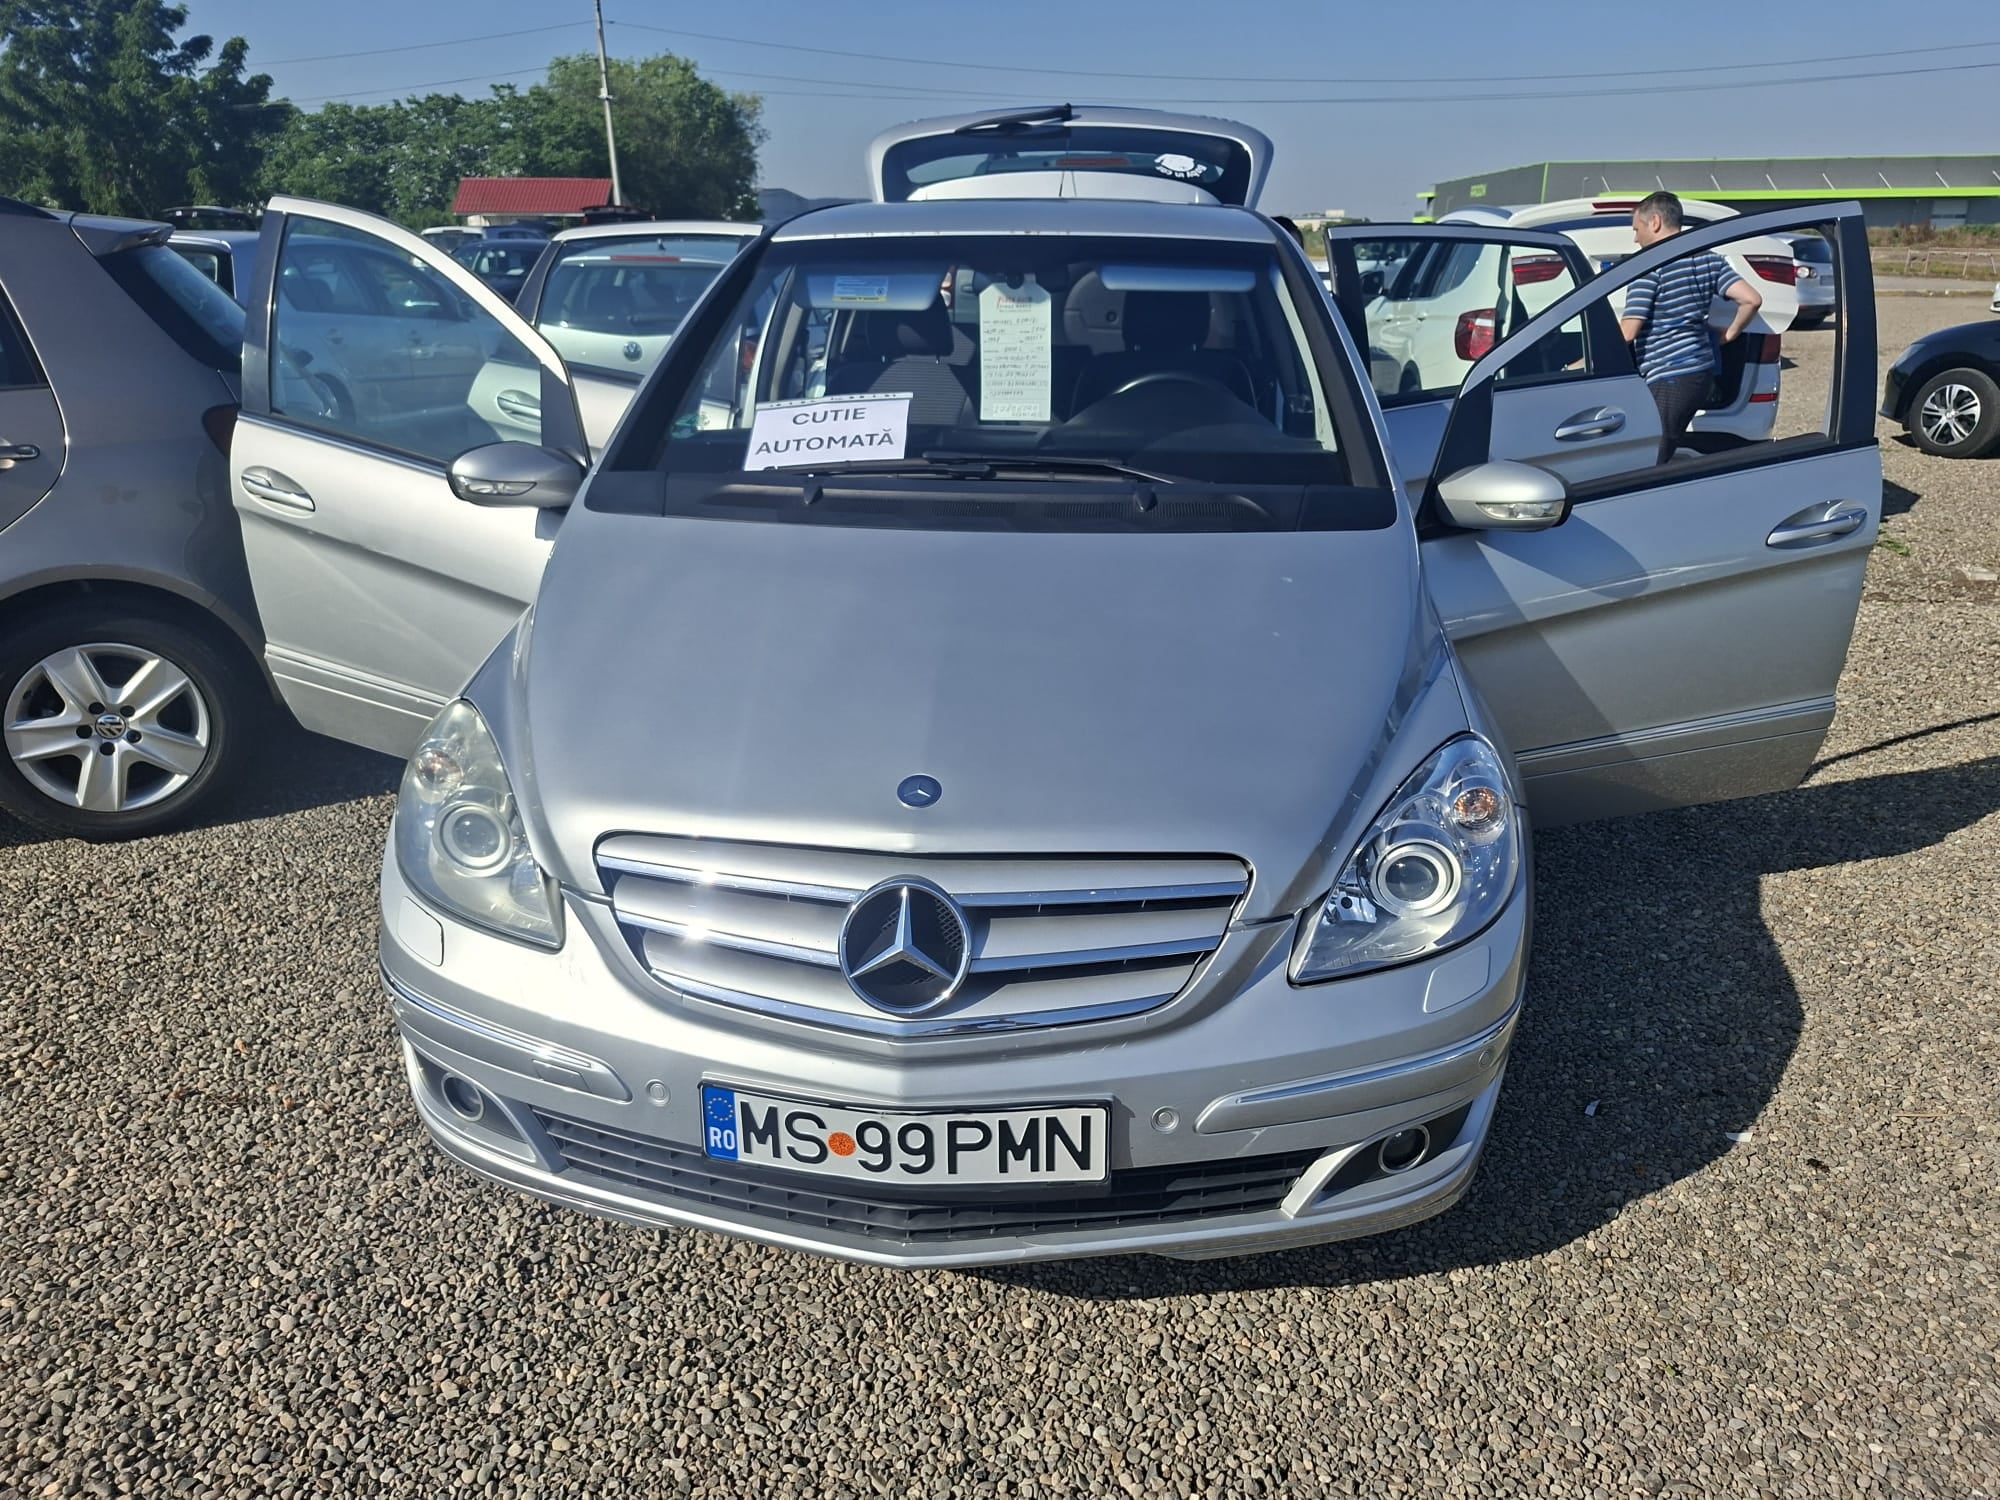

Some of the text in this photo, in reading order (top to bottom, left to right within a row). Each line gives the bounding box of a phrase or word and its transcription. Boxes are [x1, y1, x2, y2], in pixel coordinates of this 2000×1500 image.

[792, 407, 867, 425] CUTIE
[755, 428, 894, 455] AUTOMATĂ
[709, 1127, 736, 1151] RO
[740, 1101, 828, 1164] MS
